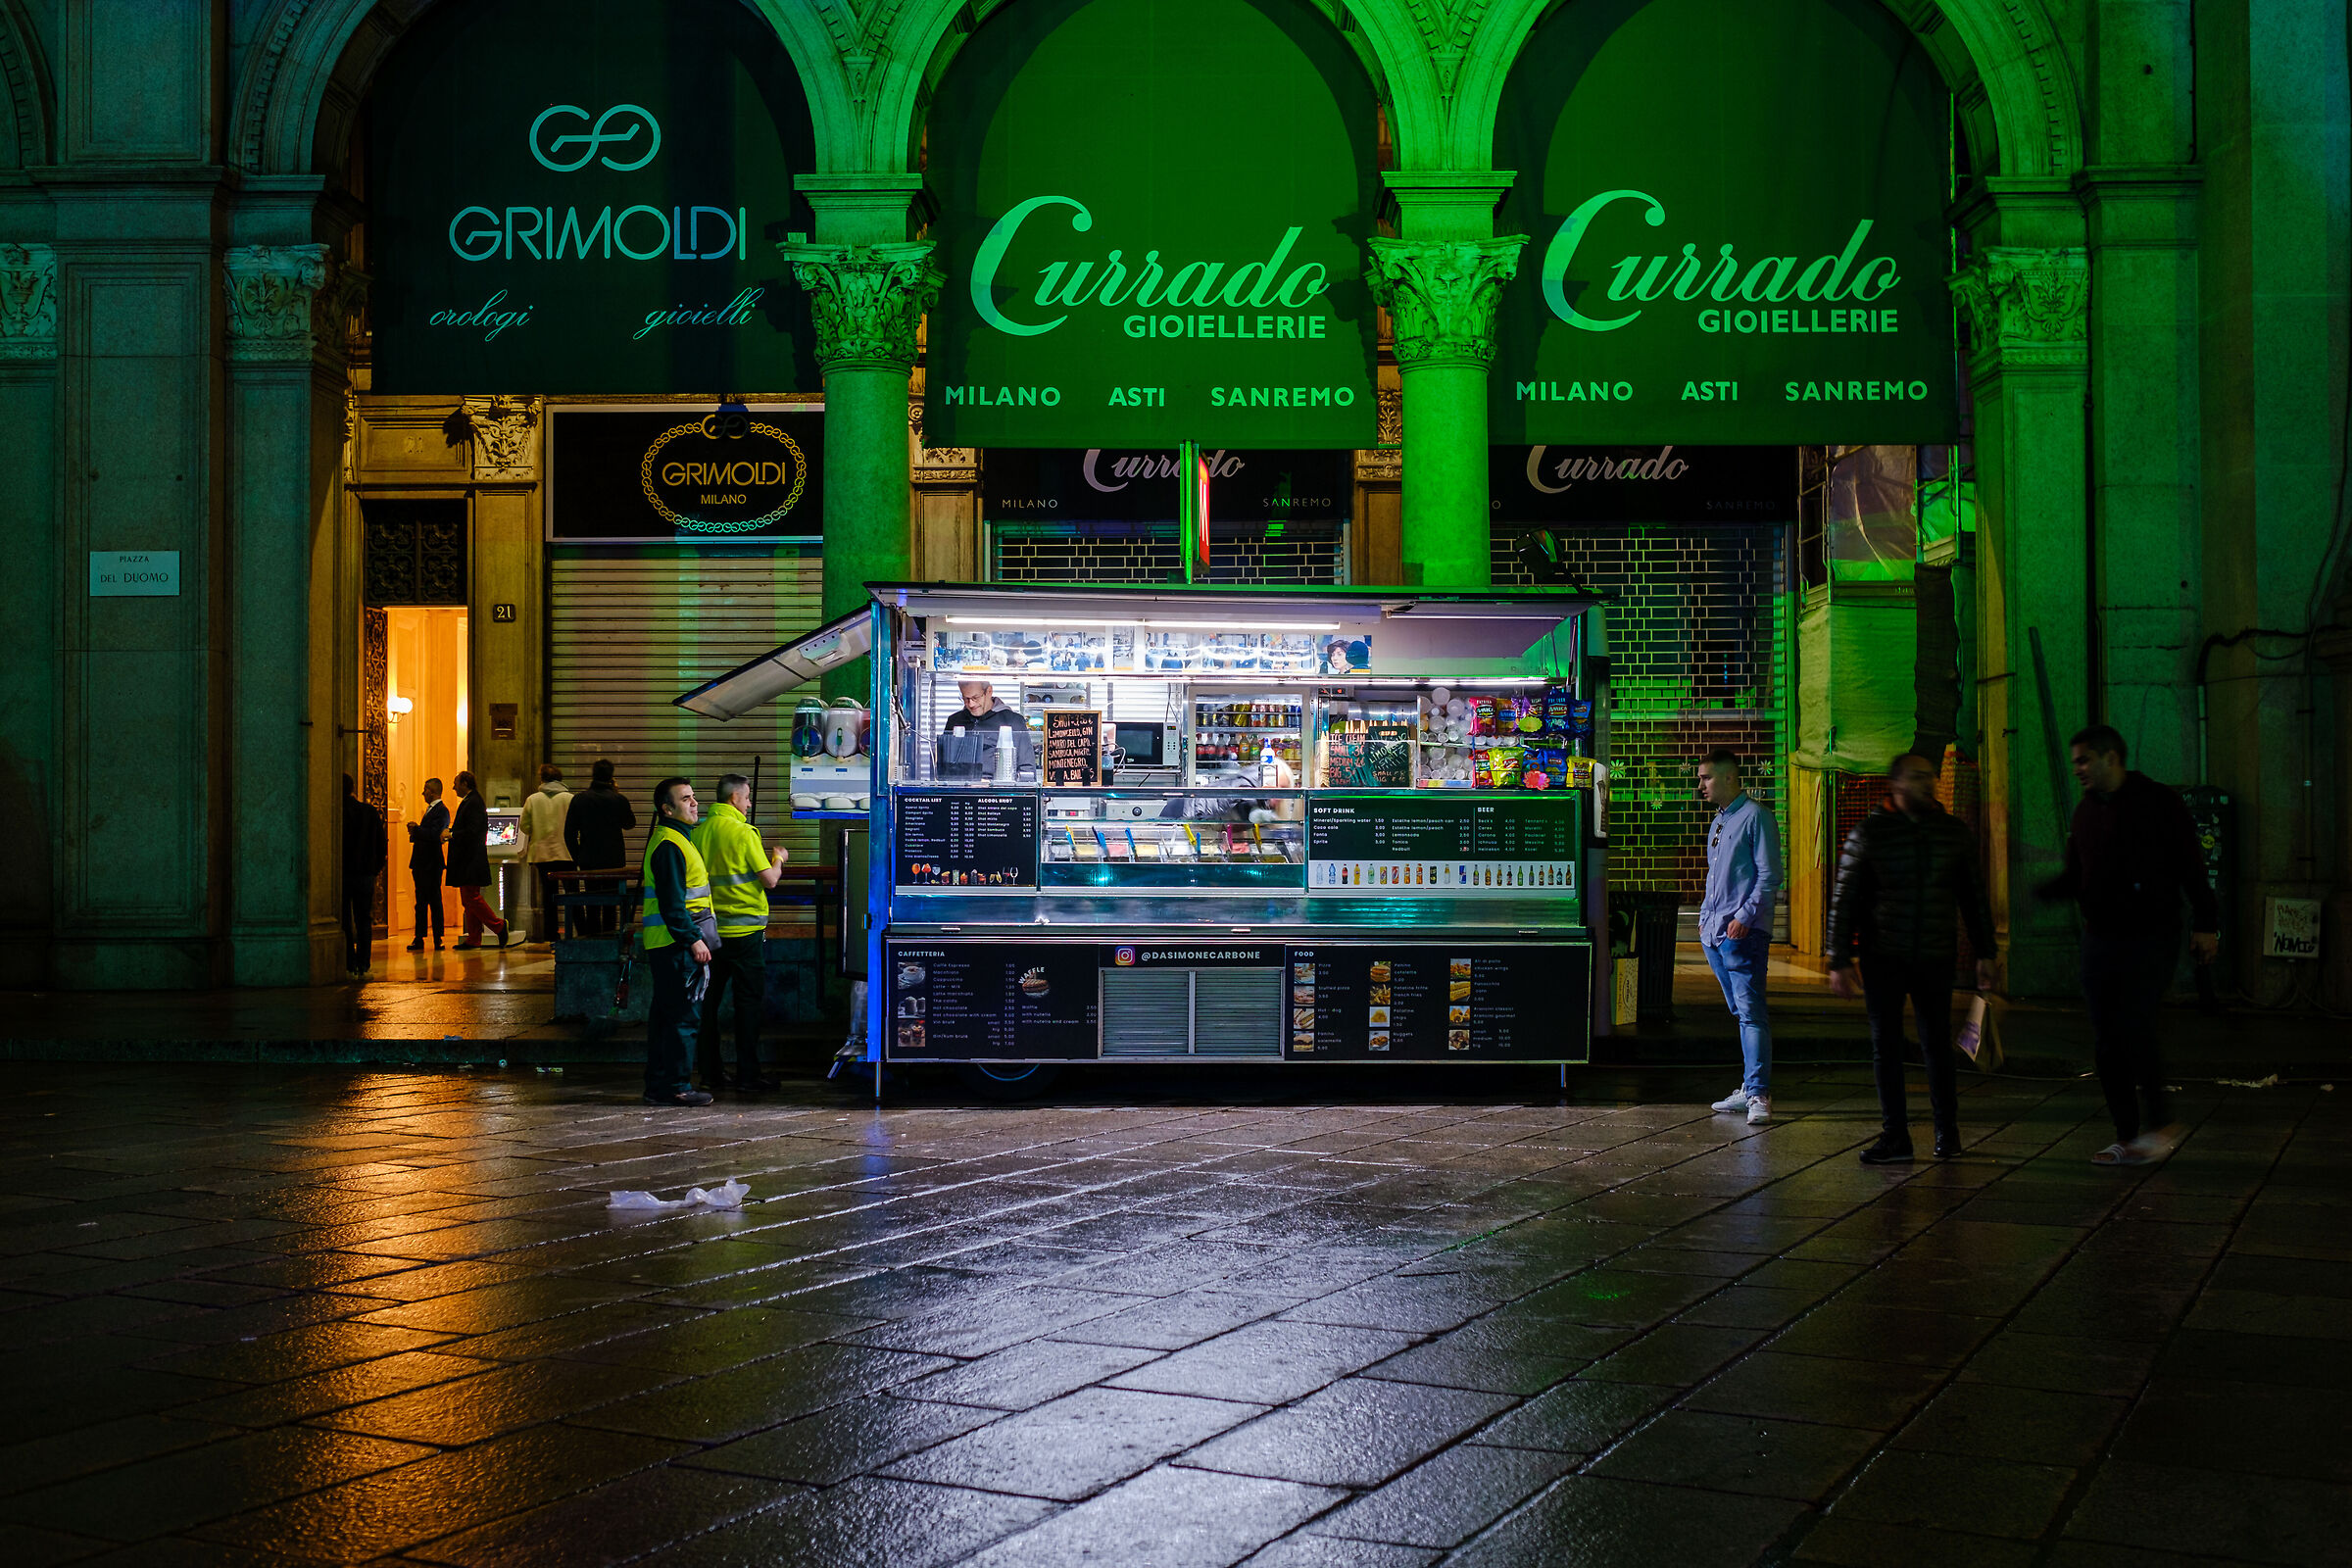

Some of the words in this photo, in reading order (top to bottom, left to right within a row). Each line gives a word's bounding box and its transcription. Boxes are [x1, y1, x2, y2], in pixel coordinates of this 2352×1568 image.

[449, 204, 747, 262] GRIMOLDI
[970, 195, 1331, 337] Currado
[1542, 189, 1901, 332] Currado
[429, 289, 534, 342] orologi
[632, 286, 764, 340] gioielli
[1698, 309, 1898, 334] GIOIELLERIE
[1123, 315, 1326, 339] GIOIELLERIE
[945, 385, 1061, 408] MILANO
[1107, 386, 1165, 408] ASTI
[1211, 386, 1355, 408] SANREMO
[1515, 380, 1634, 403] MILANO
[1681, 380, 1739, 402] ASTI
[1785, 380, 1929, 403] SANREMO
[662, 462, 786, 486] GRIMOLDI
[1083, 449, 1245, 493] Currdo
[701, 493, 747, 505] MILANO
[1002, 499, 1059, 509] MILANO
[1262, 498, 1333, 509] SANREMO
[100, 573, 118, 583] DEL
[123, 572, 170, 583] DUOMO
[496, 606, 511, 619] 21
[1141, 951, 1261, 961] @DASIMONECARBONE
[1018, 966, 1045, 984] WAFFLE
